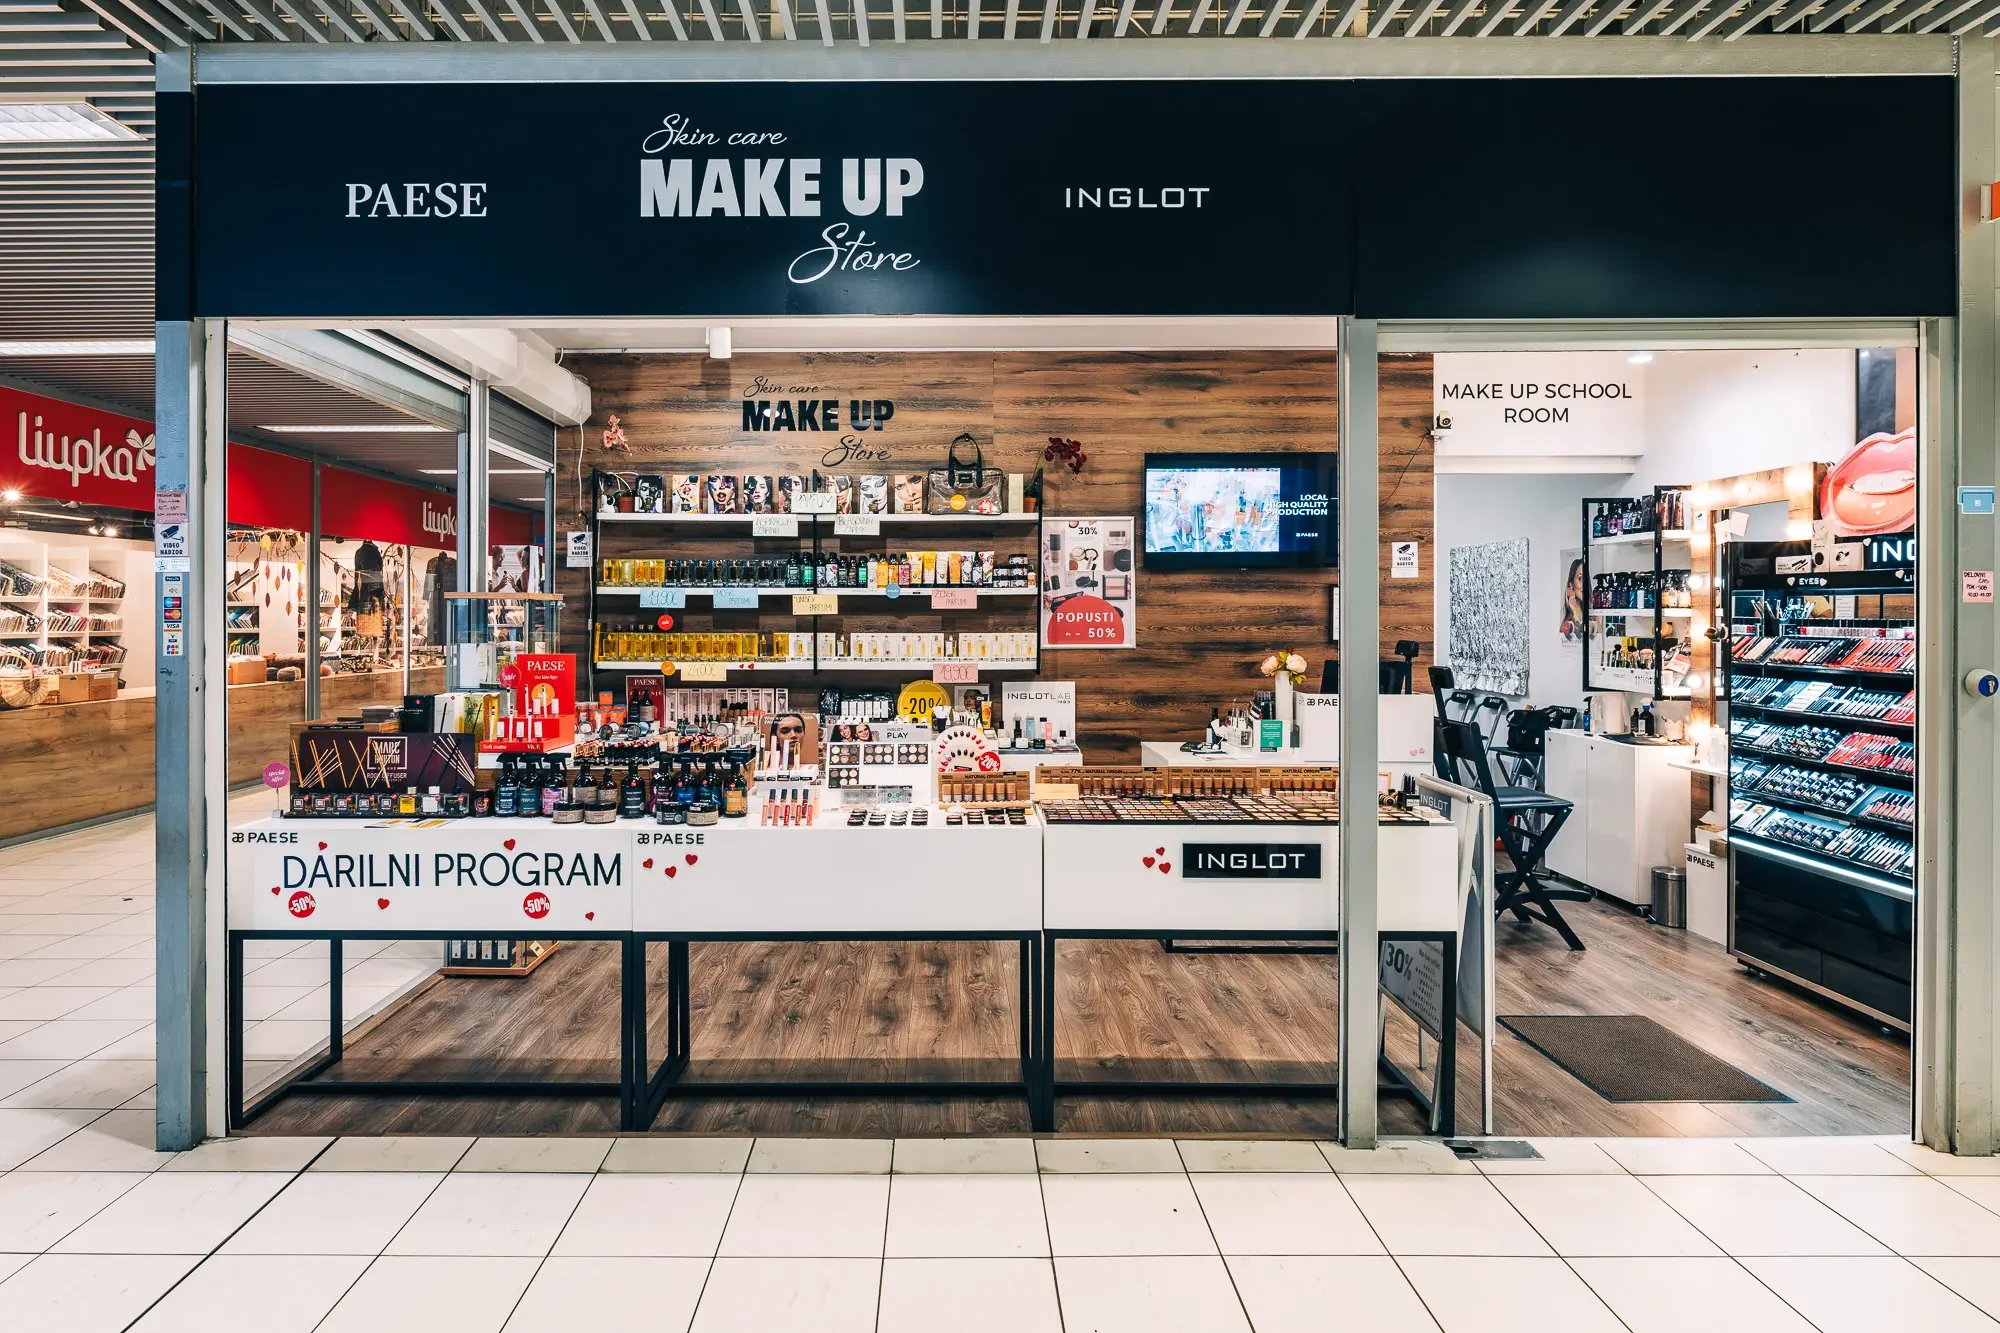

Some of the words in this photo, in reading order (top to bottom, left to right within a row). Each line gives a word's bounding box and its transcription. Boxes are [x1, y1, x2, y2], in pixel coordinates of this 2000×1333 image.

[642, 113, 720, 153] Skin
[727, 132, 788, 145] care
[640, 158, 821, 217] MAKE
[842, 158, 924, 217] UP
[345, 182, 487, 217] PAESE
[1065, 187, 1210, 208] INGLOT
[787, 222, 921, 284] Store
[743, 376, 785, 397] Skin
[789, 385, 821, 393] care
[1442, 383, 1504, 399] MAKE
[1510, 383, 1539, 399] UP
[1544, 383, 1632, 399] SCHOOL
[742, 399, 840, 431] MAKE
[850, 399, 895, 431] UP
[1504, 408, 1569, 423] ROOM
[821, 434, 892, 467] Store
[1267, 508, 1328, 516] PRODUCTION
[1078, 527, 1098, 535] 30%
[1798, 577, 1819, 585] EYES
[1056, 612, 1114, 623] POPUSTI
[1088, 628, 1116, 638] 50%
[527, 660, 565, 671] PAESE
[248, 832, 298, 844] PAESE
[653, 833, 704, 845] PAESE
[1198, 853, 1305, 869] INGLOT
[1692, 856, 1715, 869] PAESE
[283, 853, 420, 889] DARILNI
[434, 852, 621, 887] PROGRAM
[289, 894, 316, 913] -50%
[524, 896, 550, 914] -50%
[1385, 942, 1413, 981] 30%
